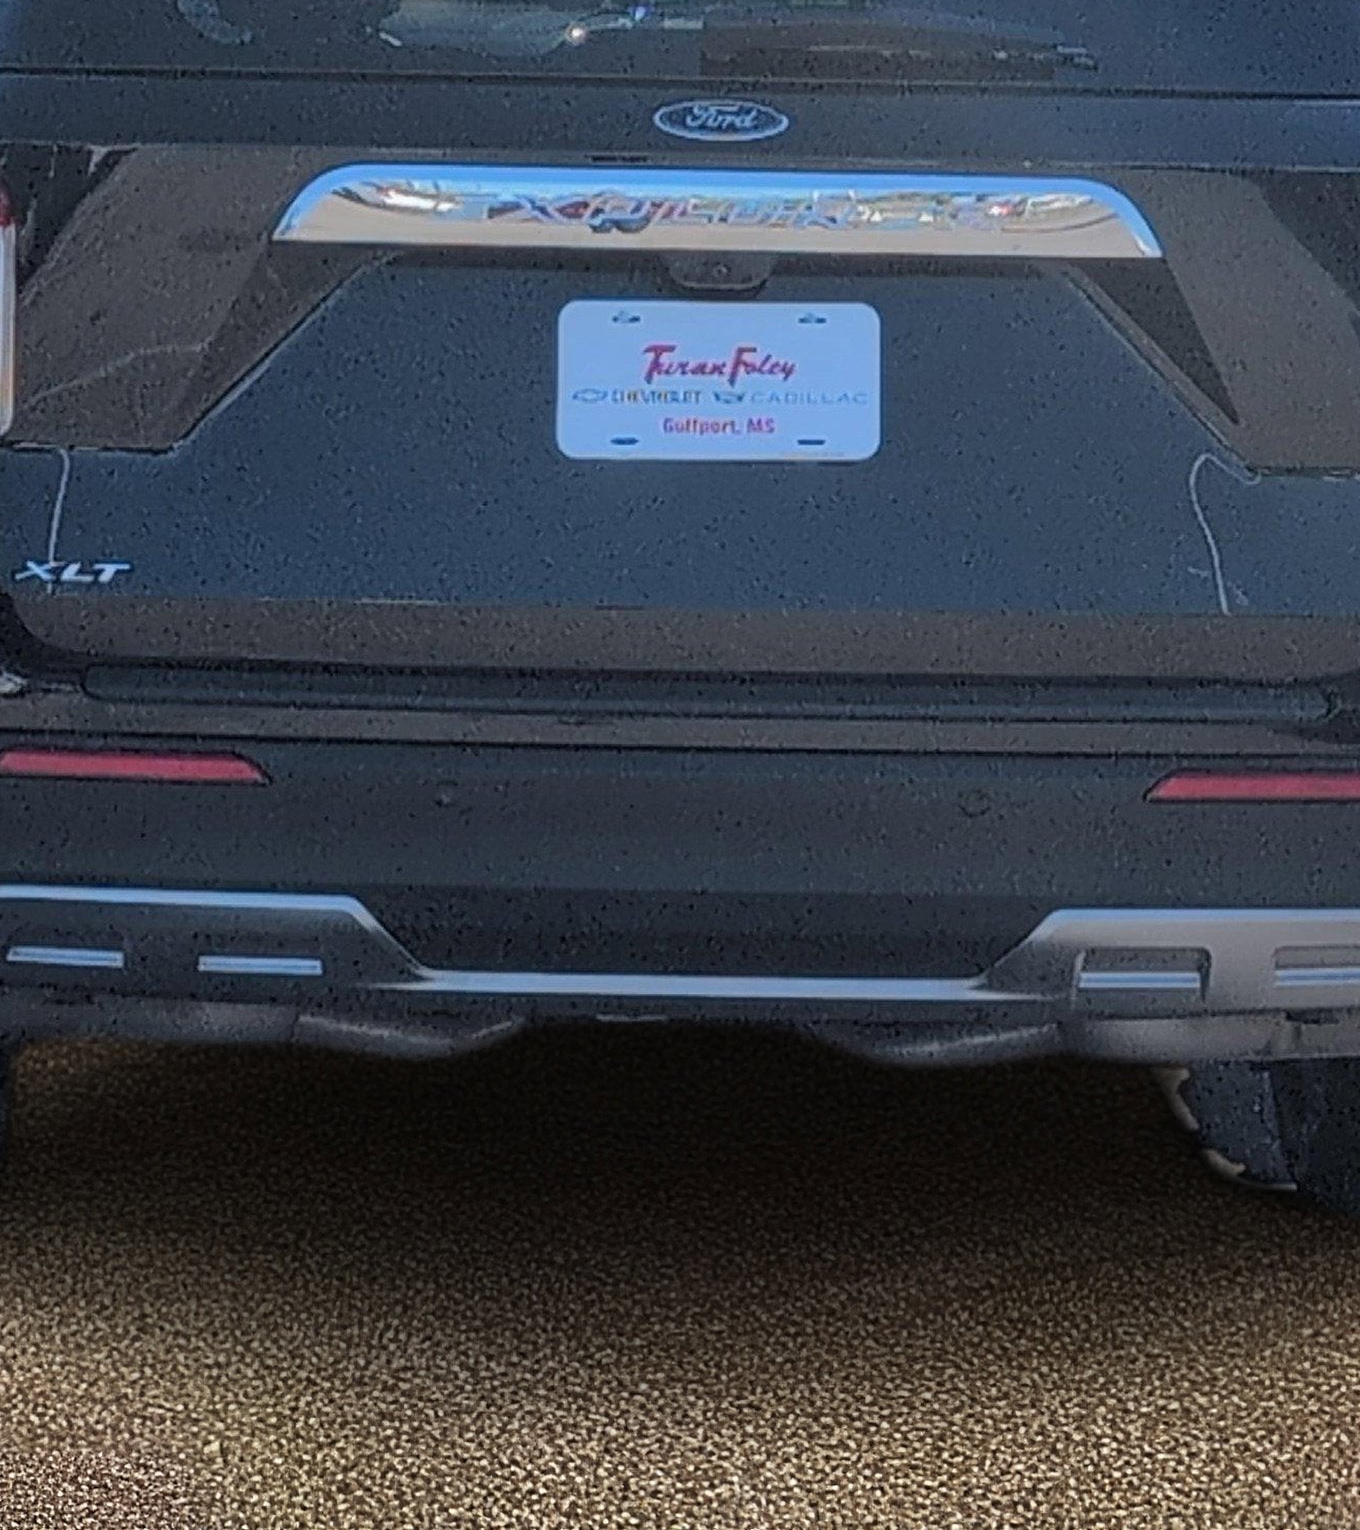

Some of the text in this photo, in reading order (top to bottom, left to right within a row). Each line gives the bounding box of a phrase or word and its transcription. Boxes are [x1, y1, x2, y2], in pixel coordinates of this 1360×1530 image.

[750, 391, 868, 406] CADILLAC
[746, 417, 776, 434] MS
[13, 560, 132, 584] XLT
